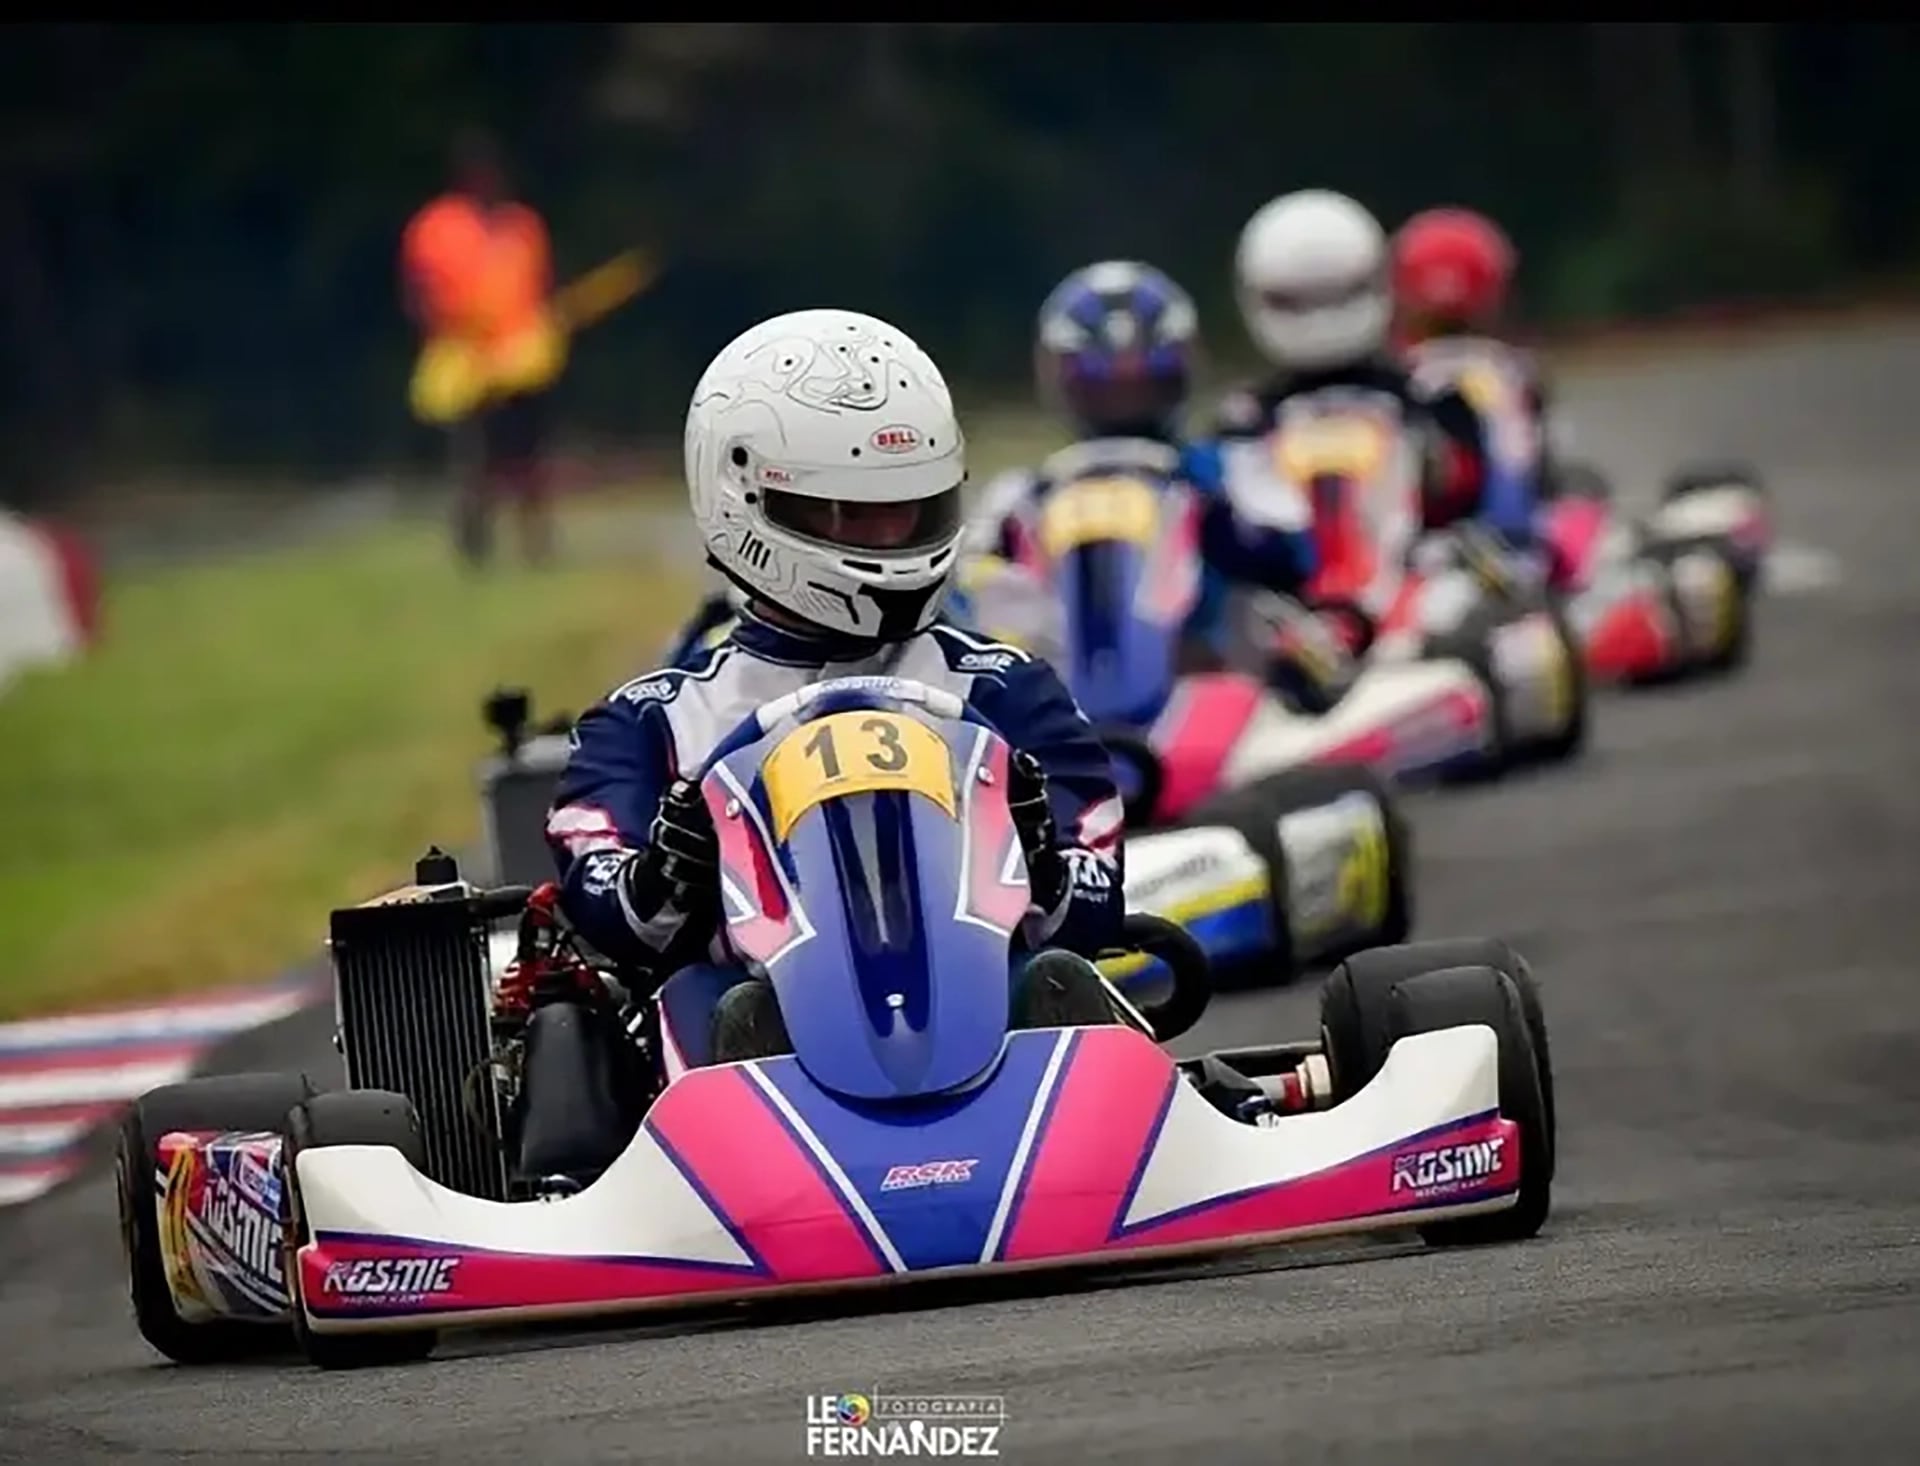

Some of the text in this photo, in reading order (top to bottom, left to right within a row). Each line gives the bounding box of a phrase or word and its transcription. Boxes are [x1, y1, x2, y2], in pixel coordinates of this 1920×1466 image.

[877, 431, 916, 446] BELL
[765, 470, 792, 482] BELL
[805, 719, 908, 778] 13
